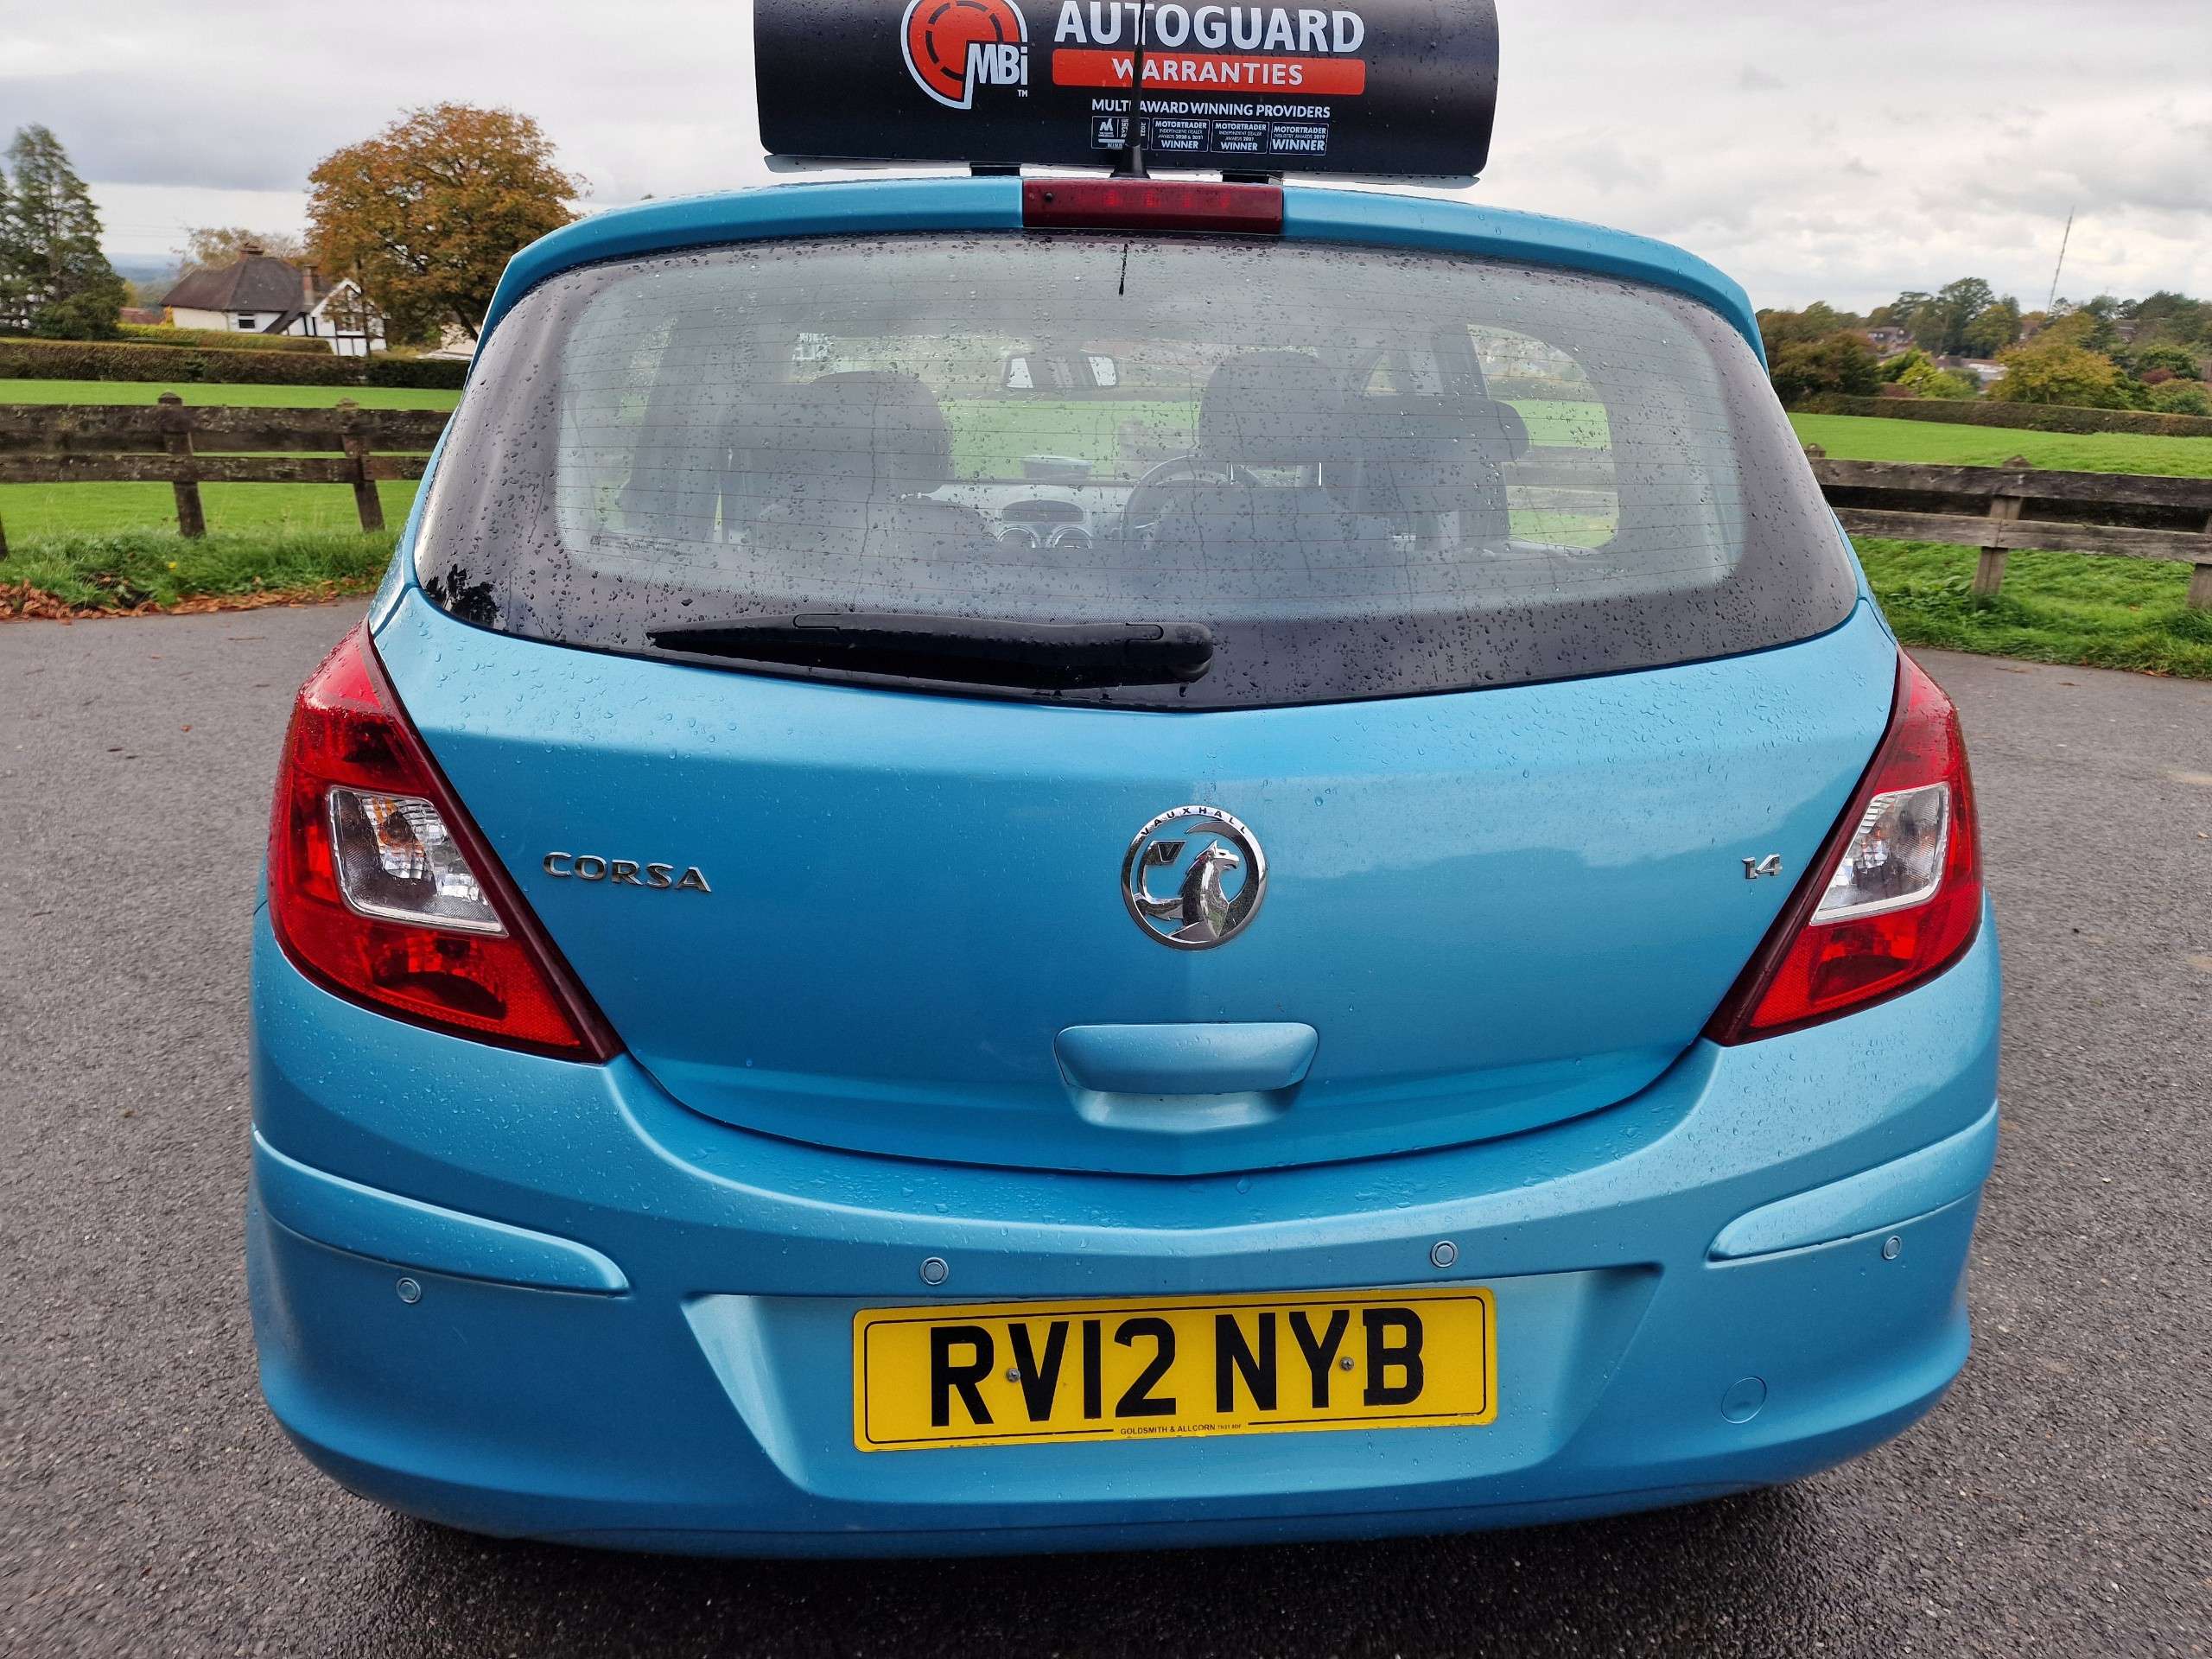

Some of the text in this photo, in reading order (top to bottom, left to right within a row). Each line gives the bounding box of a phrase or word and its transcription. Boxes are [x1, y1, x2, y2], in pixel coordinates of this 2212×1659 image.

[1053, 0, 1365, 53] AUTOGUARD
[1112, 57, 1304, 86] WARRANTIES
[1190, 102, 1253, 116] WINNING
[1255, 105, 1331, 118] PROVIDERS
[1154, 120, 1207, 129] MOTORTRADER
[1161, 140, 1198, 149] WINNER
[1221, 142, 1258, 150] WINNER
[1272, 139, 1325, 151] WINNER
[1141, 807, 1247, 836] VAUXHALL
[543, 851, 712, 893] CORSA
[930, 1307, 1425, 1427] RV12 NYB
[1120, 1426, 1167, 1435] GOLDSMITH
[1177, 1424, 1216, 1433] ALLCORN
